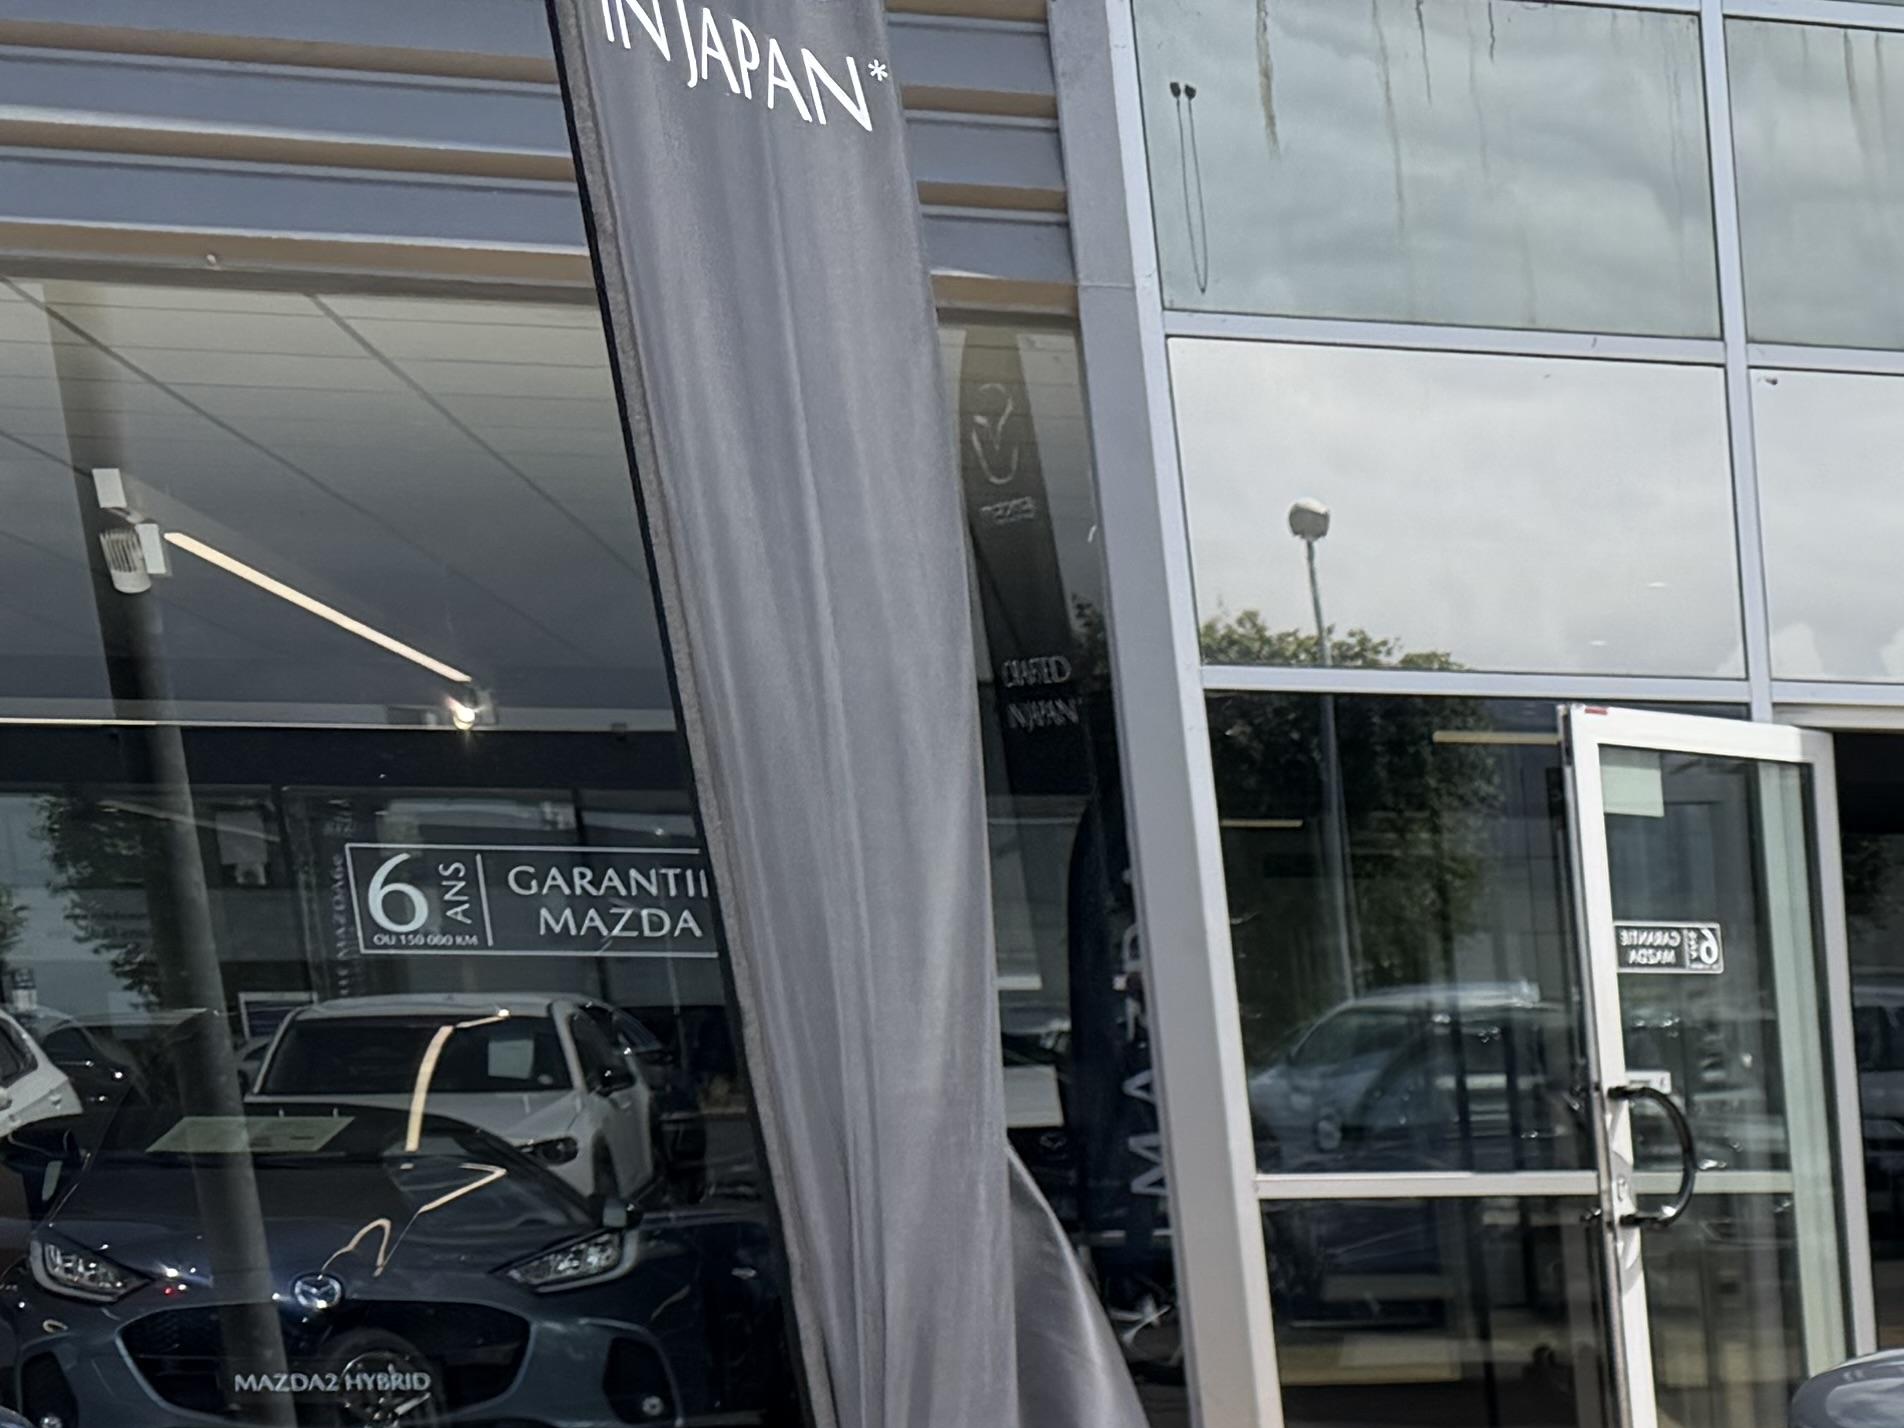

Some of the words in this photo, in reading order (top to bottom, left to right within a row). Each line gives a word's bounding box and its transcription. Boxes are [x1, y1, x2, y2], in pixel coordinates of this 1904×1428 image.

[367, 852, 430, 933] 6
[438, 861, 474, 924] ANS
[507, 865, 709, 898] GARANTI
[538, 907, 704, 938] MAZDA
[234, 1372, 340, 1393] MAZDA2
[344, 1372, 432, 1392] HYBRID
